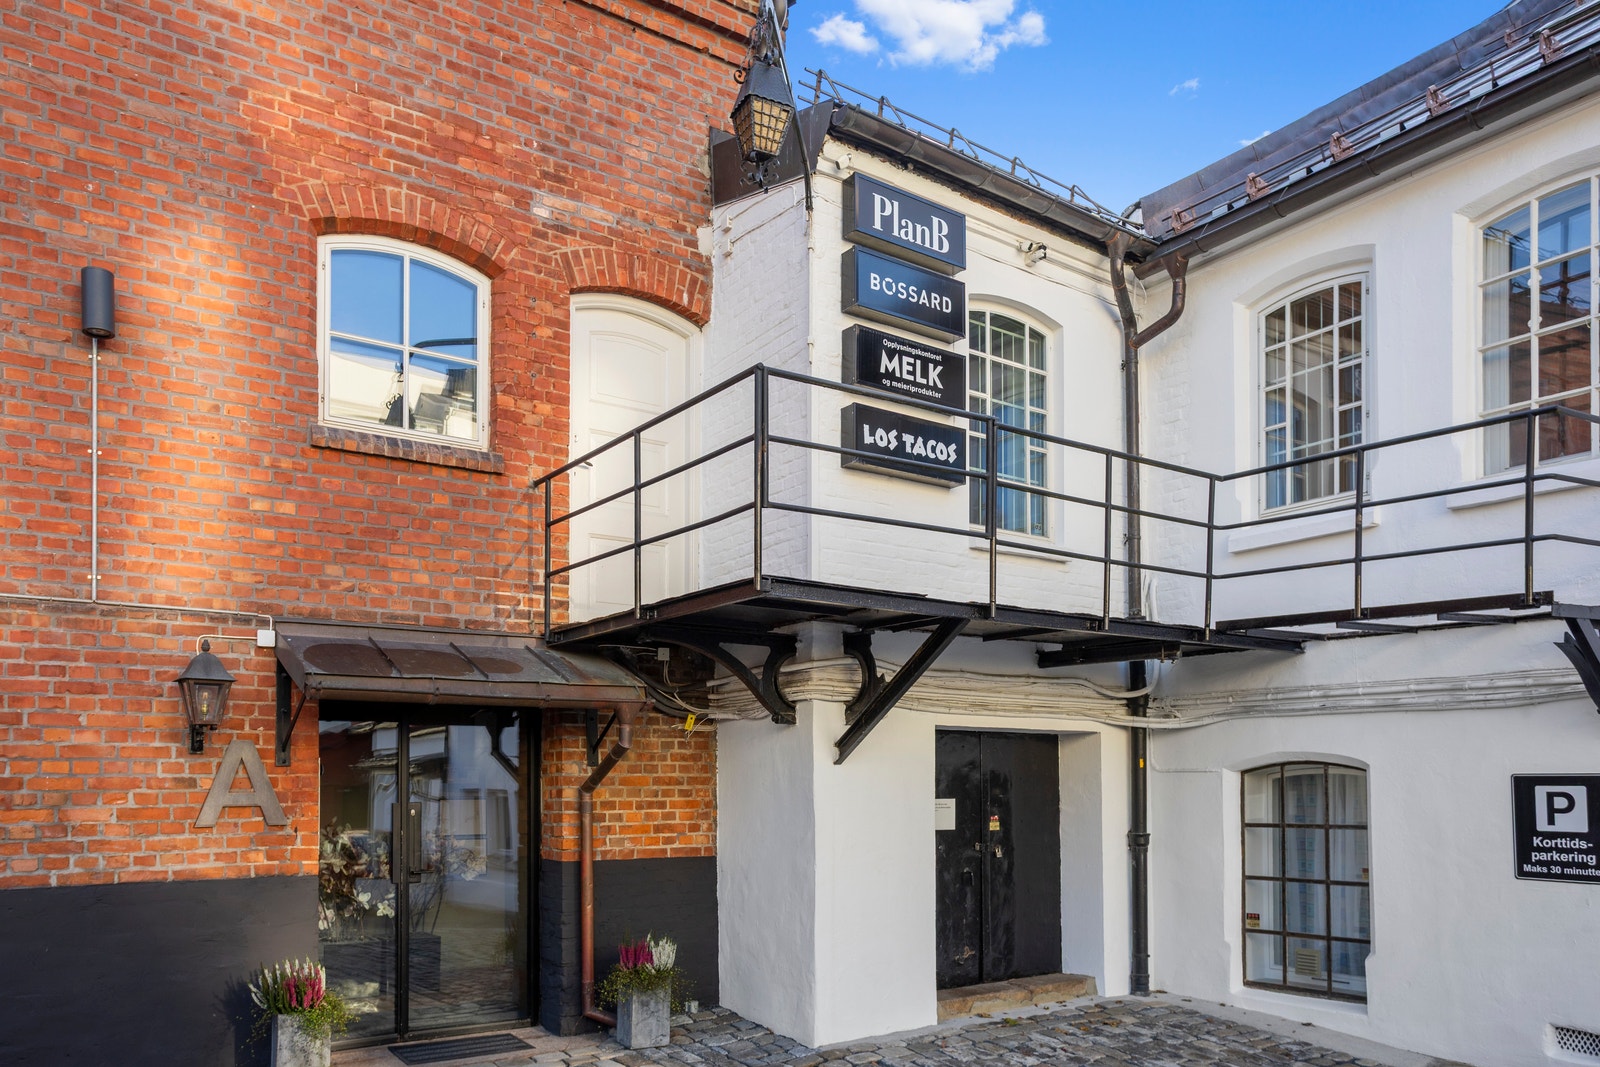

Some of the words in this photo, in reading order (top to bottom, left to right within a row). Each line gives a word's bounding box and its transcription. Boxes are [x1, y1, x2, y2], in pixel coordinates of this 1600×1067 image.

[870, 272, 952, 314] BOSSARD
[882, 338, 942, 361] Opplysningskontoret
[879, 349, 944, 389] MELK
[882, 378, 891, 387] og
[891, 381, 942, 399] meieriprodukter
[863, 423, 898, 451] LOS
[902, 432, 957, 464] TACOS
[194, 740, 287, 828] A
[1546, 791, 1575, 826] P
[1533, 836, 1593, 849] Korttids-
[1523, 864, 1548, 873] Maks
[1550, 865, 1562, 874] 30
[1531, 851, 1596, 866] parkering
